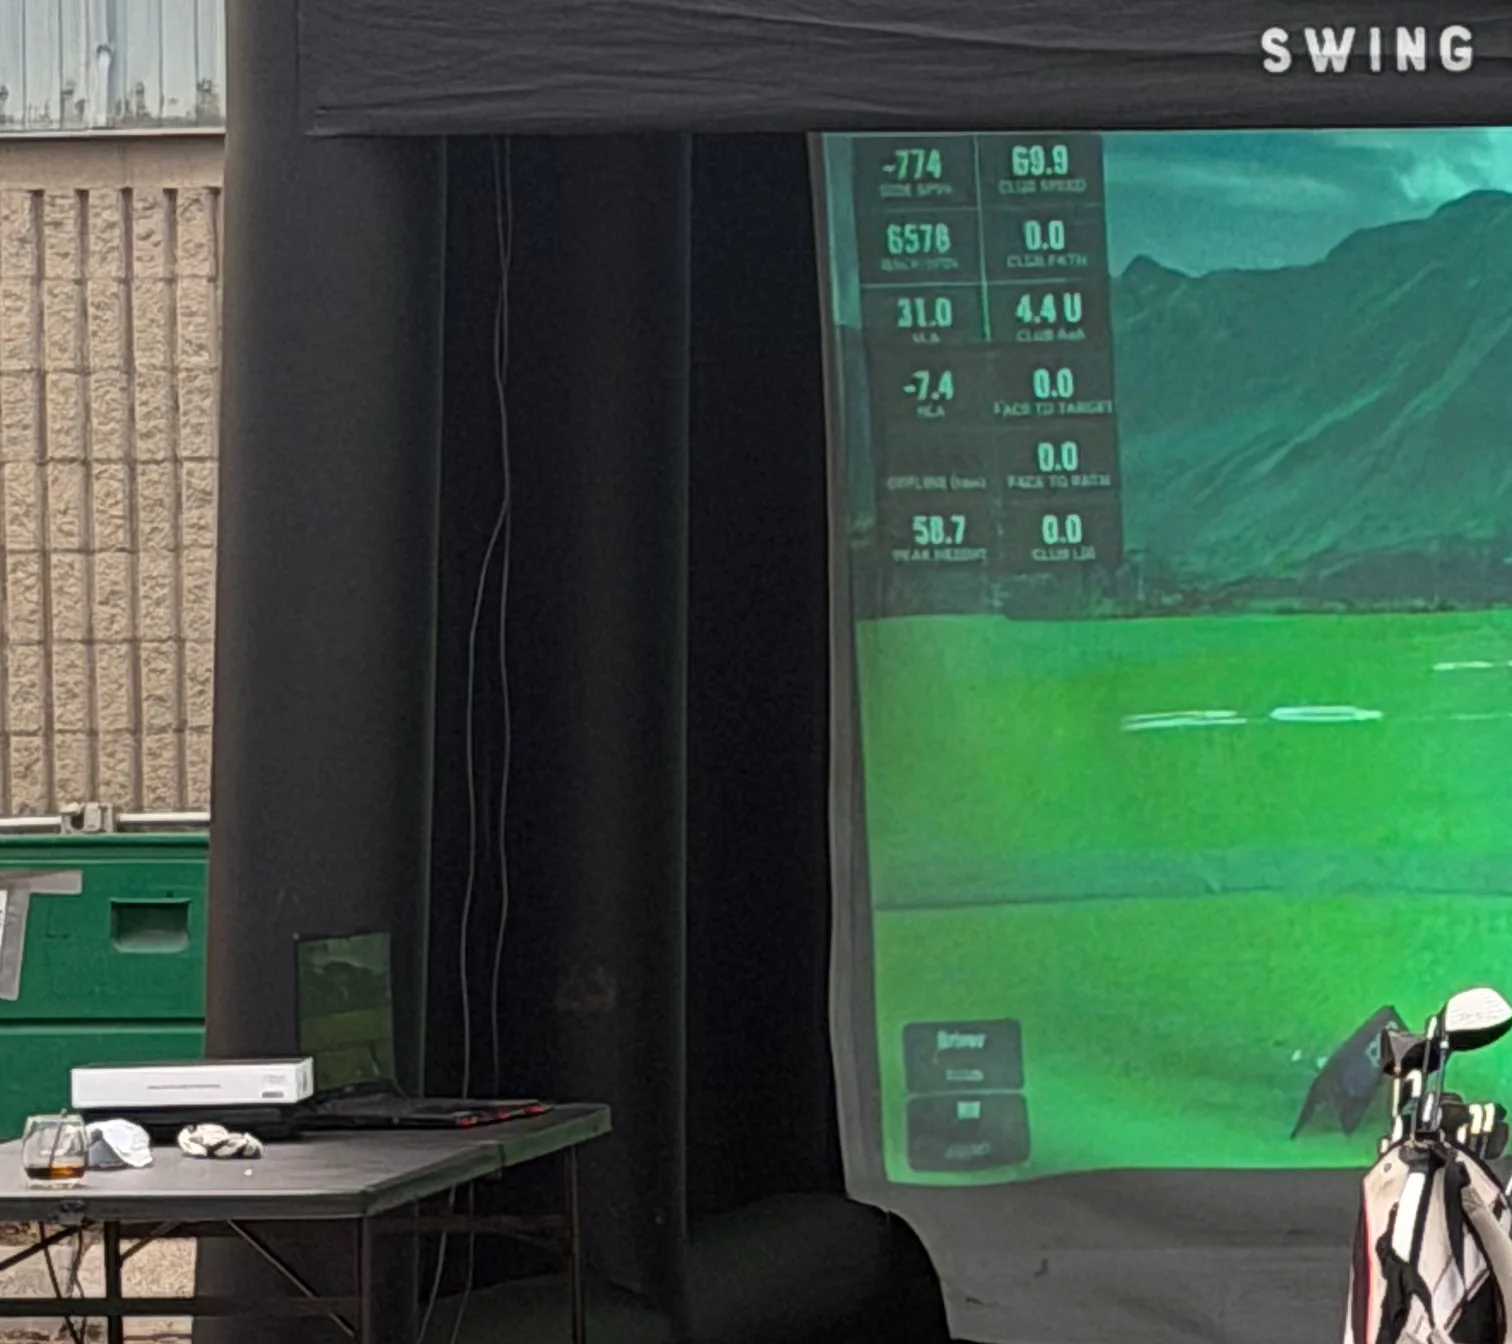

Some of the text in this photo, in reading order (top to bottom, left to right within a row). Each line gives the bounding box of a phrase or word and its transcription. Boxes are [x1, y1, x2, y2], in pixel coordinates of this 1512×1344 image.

[1260, 24, 1473, 75] SWING
[883, 149, 942, 179] -774
[1012, 144, 1068, 176] 69.9
[1024, 220, 1065, 251] 0.0
[897, 297, 953, 328] 31.0
[903, 370, 954, 401] -7.4
[1033, 367, 1074, 398] 0.0
[1037, 441, 1079, 472] 0.0
[1042, 514, 1082, 545] 0.0
